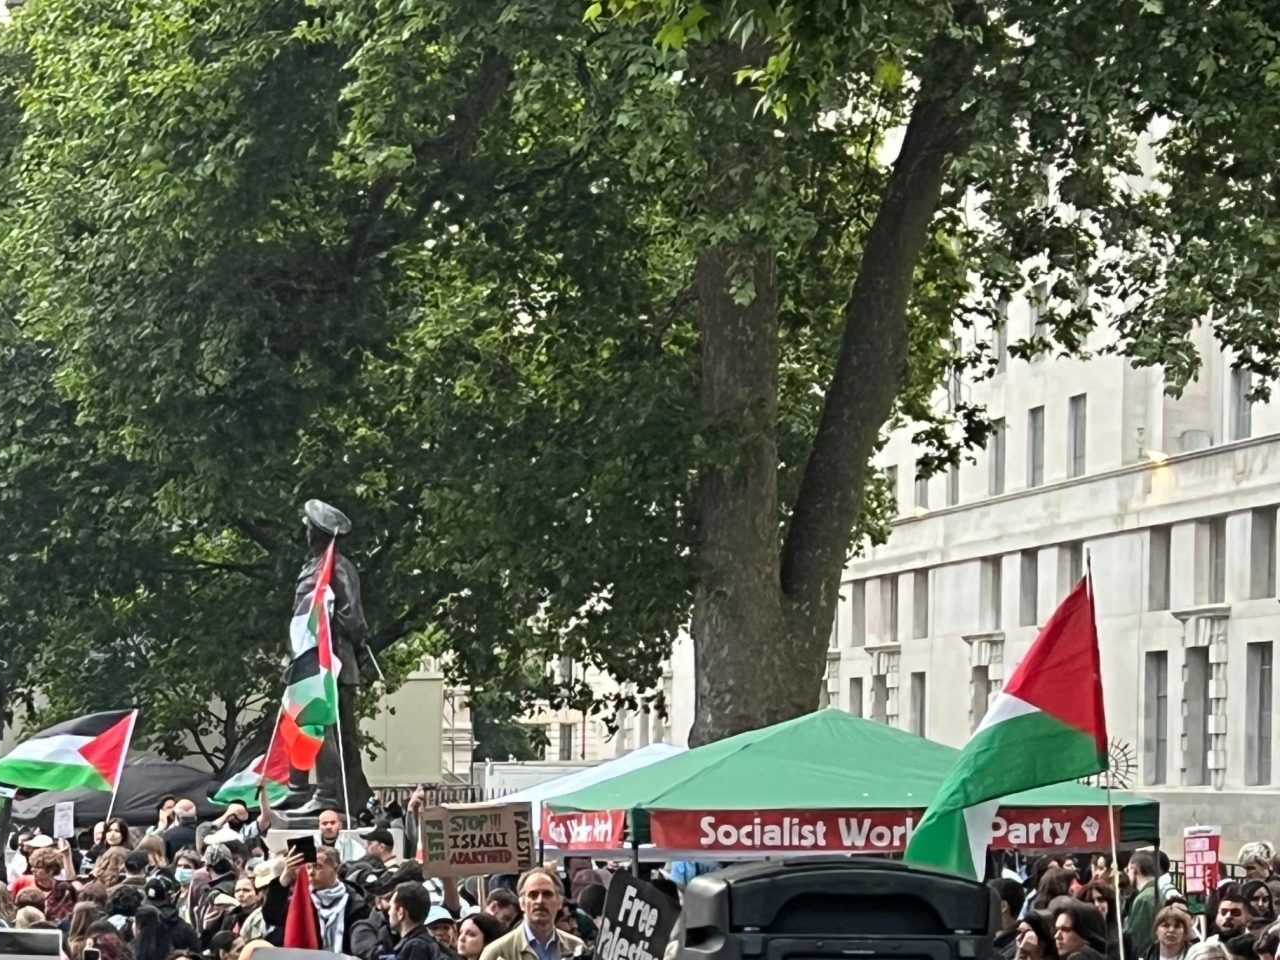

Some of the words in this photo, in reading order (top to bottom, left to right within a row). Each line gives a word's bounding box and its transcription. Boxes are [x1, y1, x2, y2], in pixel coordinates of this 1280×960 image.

[449, 832, 508, 849] ISRAELI
[700, 816, 826, 847] Socialist
[838, 817, 917, 847] Work
[987, 817, 1071, 845] Party
[618, 885, 658, 937] Free
